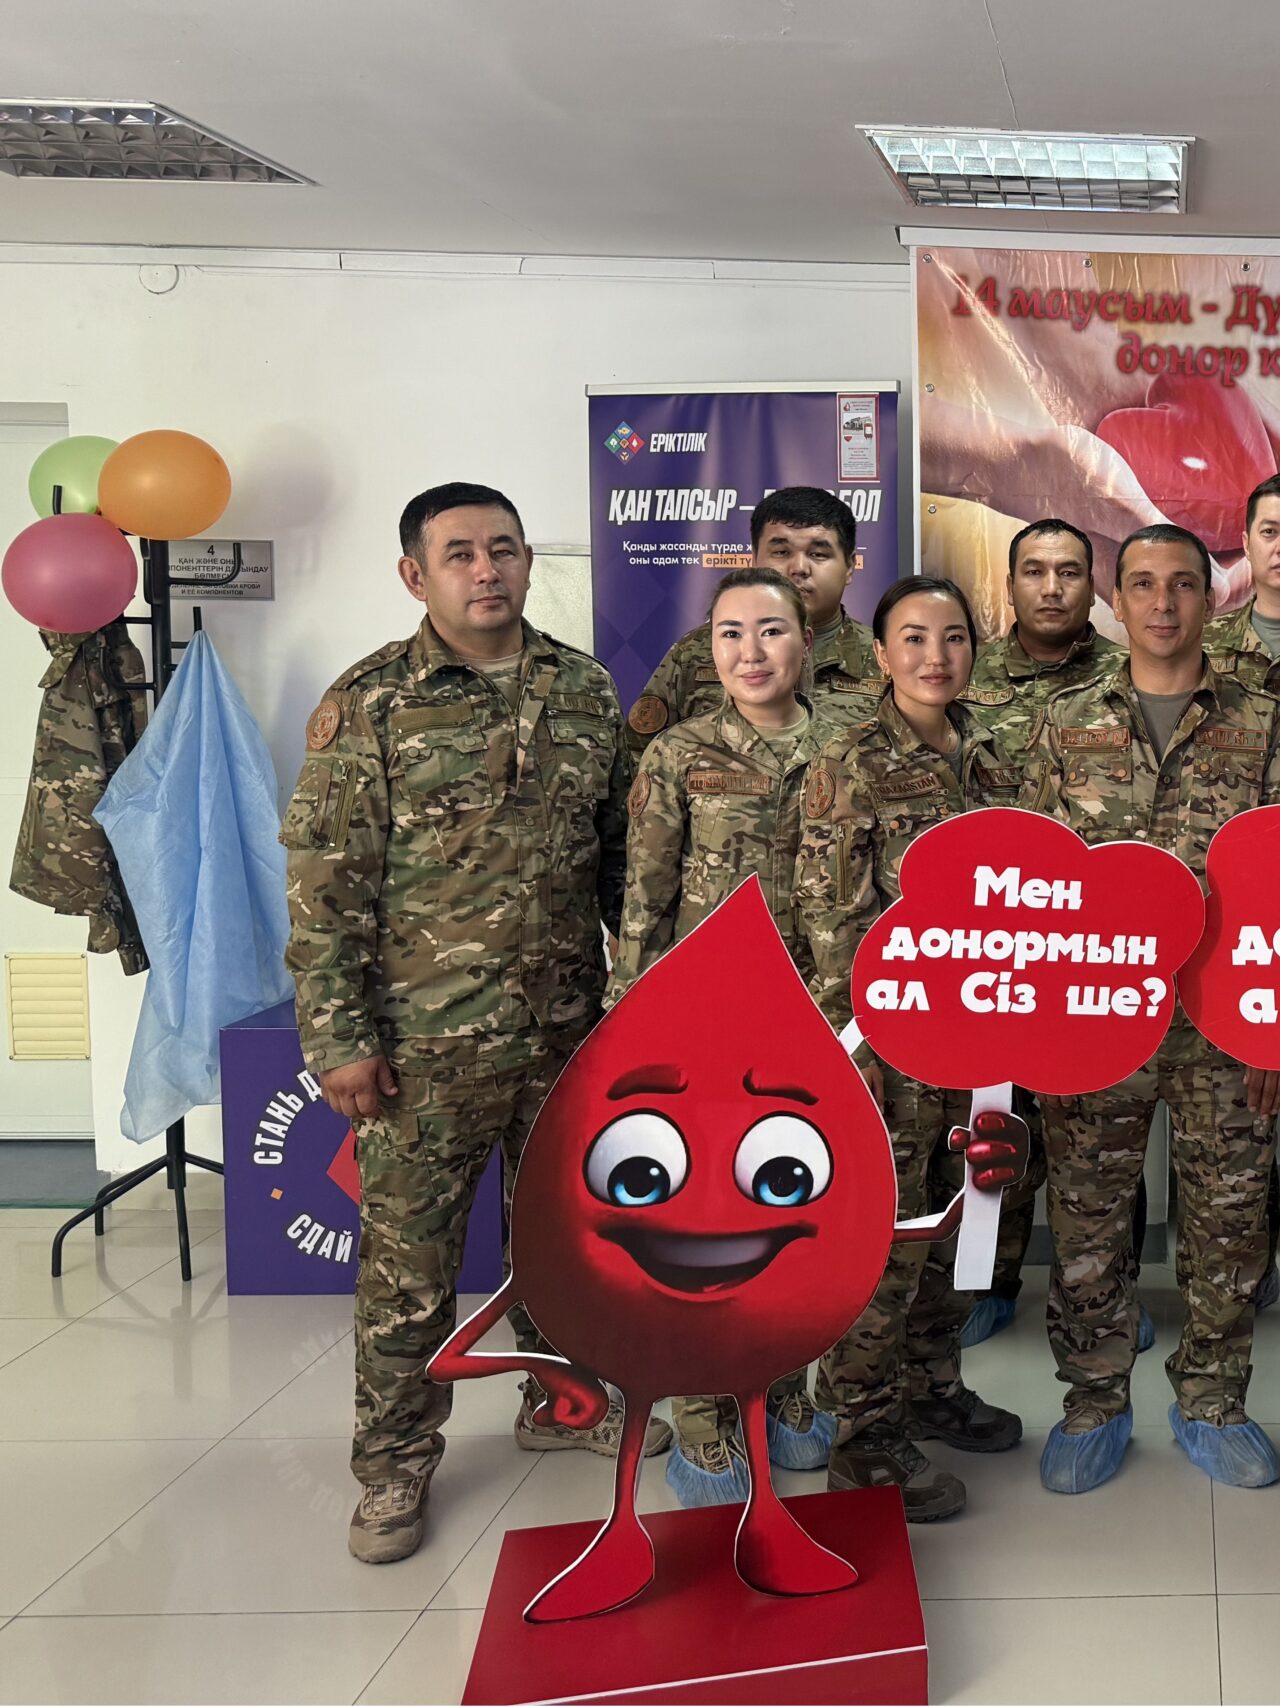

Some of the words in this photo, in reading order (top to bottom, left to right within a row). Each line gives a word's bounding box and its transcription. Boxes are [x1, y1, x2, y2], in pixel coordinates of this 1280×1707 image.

[951, 275, 1000, 317] 14
[1008, 288, 1193, 331] маусым
[1116, 333, 1250, 388] донор
[649, 432, 708, 453] ЕРІКТІЛІК
[608, 489, 652, 525] ҚАН
[655, 489, 737, 522] ТАПСЫР
[178, 558, 194, 566] ҚАН
[207, 545, 215, 556] 4
[622, 541, 657, 553] Қанды
[659, 543, 708, 553] жасанды
[711, 544, 743, 555] түрде
[629, 556, 650, 566] оны
[652, 556, 679, 566] адам
[681, 556, 700, 566] тек
[705, 554, 738, 567] ерікті
[973, 865, 1083, 910] Мен
[881, 926, 1158, 970] донормын
[865, 977, 930, 1012] ал
[960, 971, 1037, 1014] Сіз
[1066, 976, 1168, 1018] ше?
[1239, 988, 1279, 1025] а
[253, 1091, 304, 1165] СТАНЬ
[286, 1213, 353, 1264] СДАЙ
